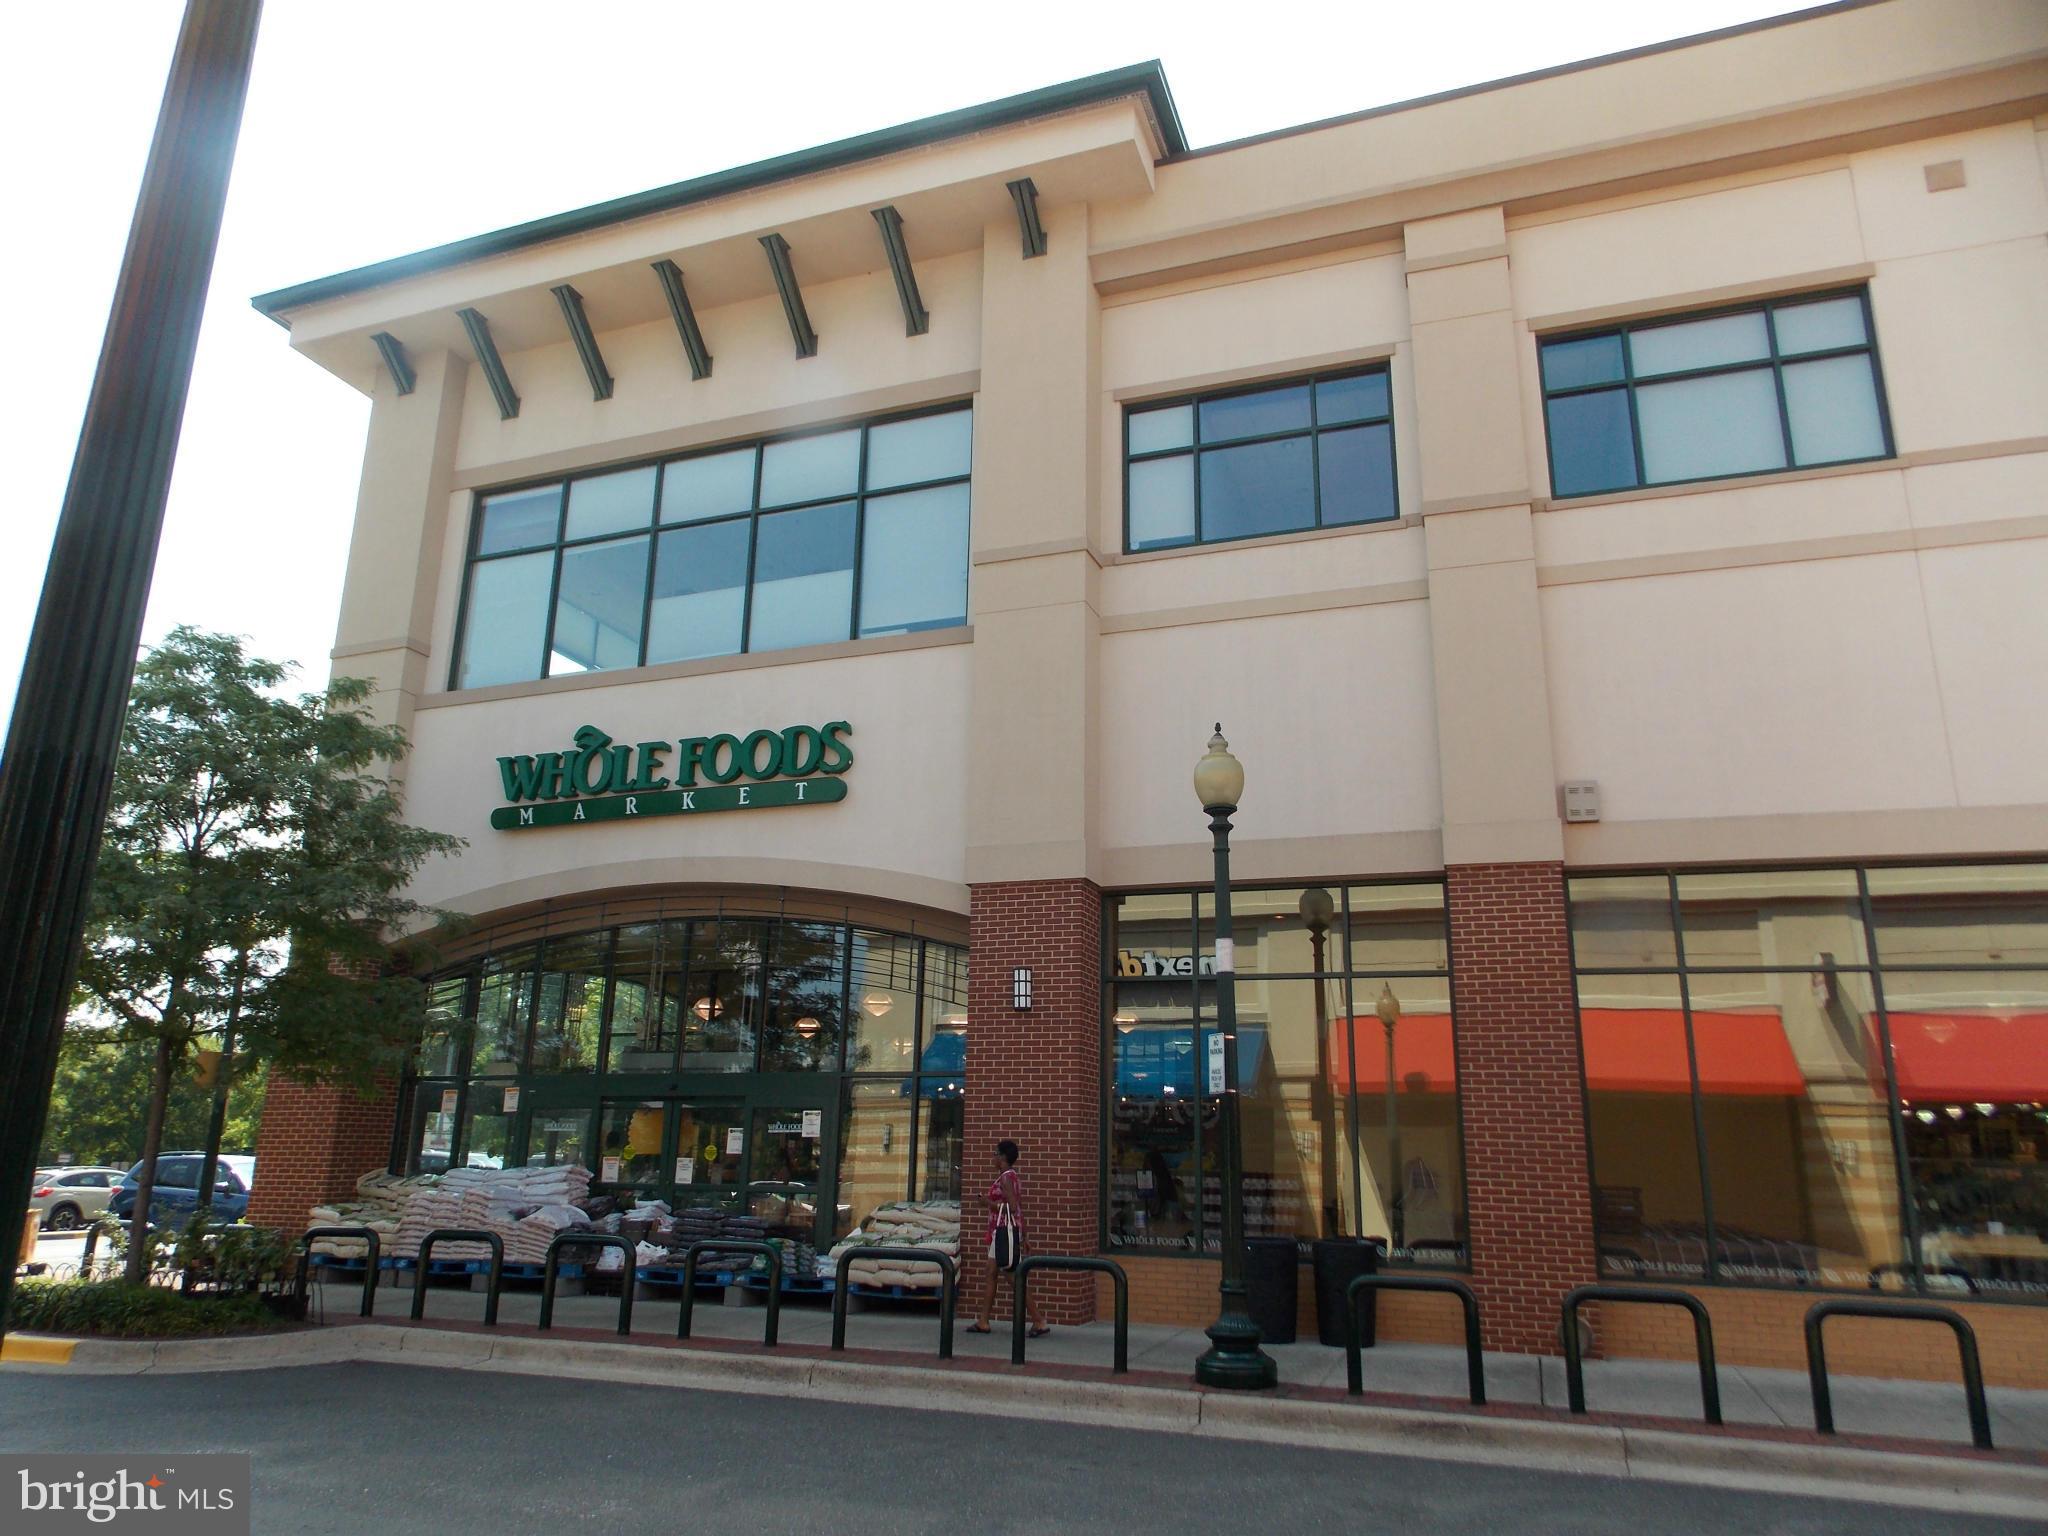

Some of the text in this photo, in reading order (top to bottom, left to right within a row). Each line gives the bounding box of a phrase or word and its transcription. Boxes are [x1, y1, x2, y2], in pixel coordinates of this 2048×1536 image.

[496, 720, 853, 802] WHOLE FOODS
[519, 782, 808, 825] MARKET
